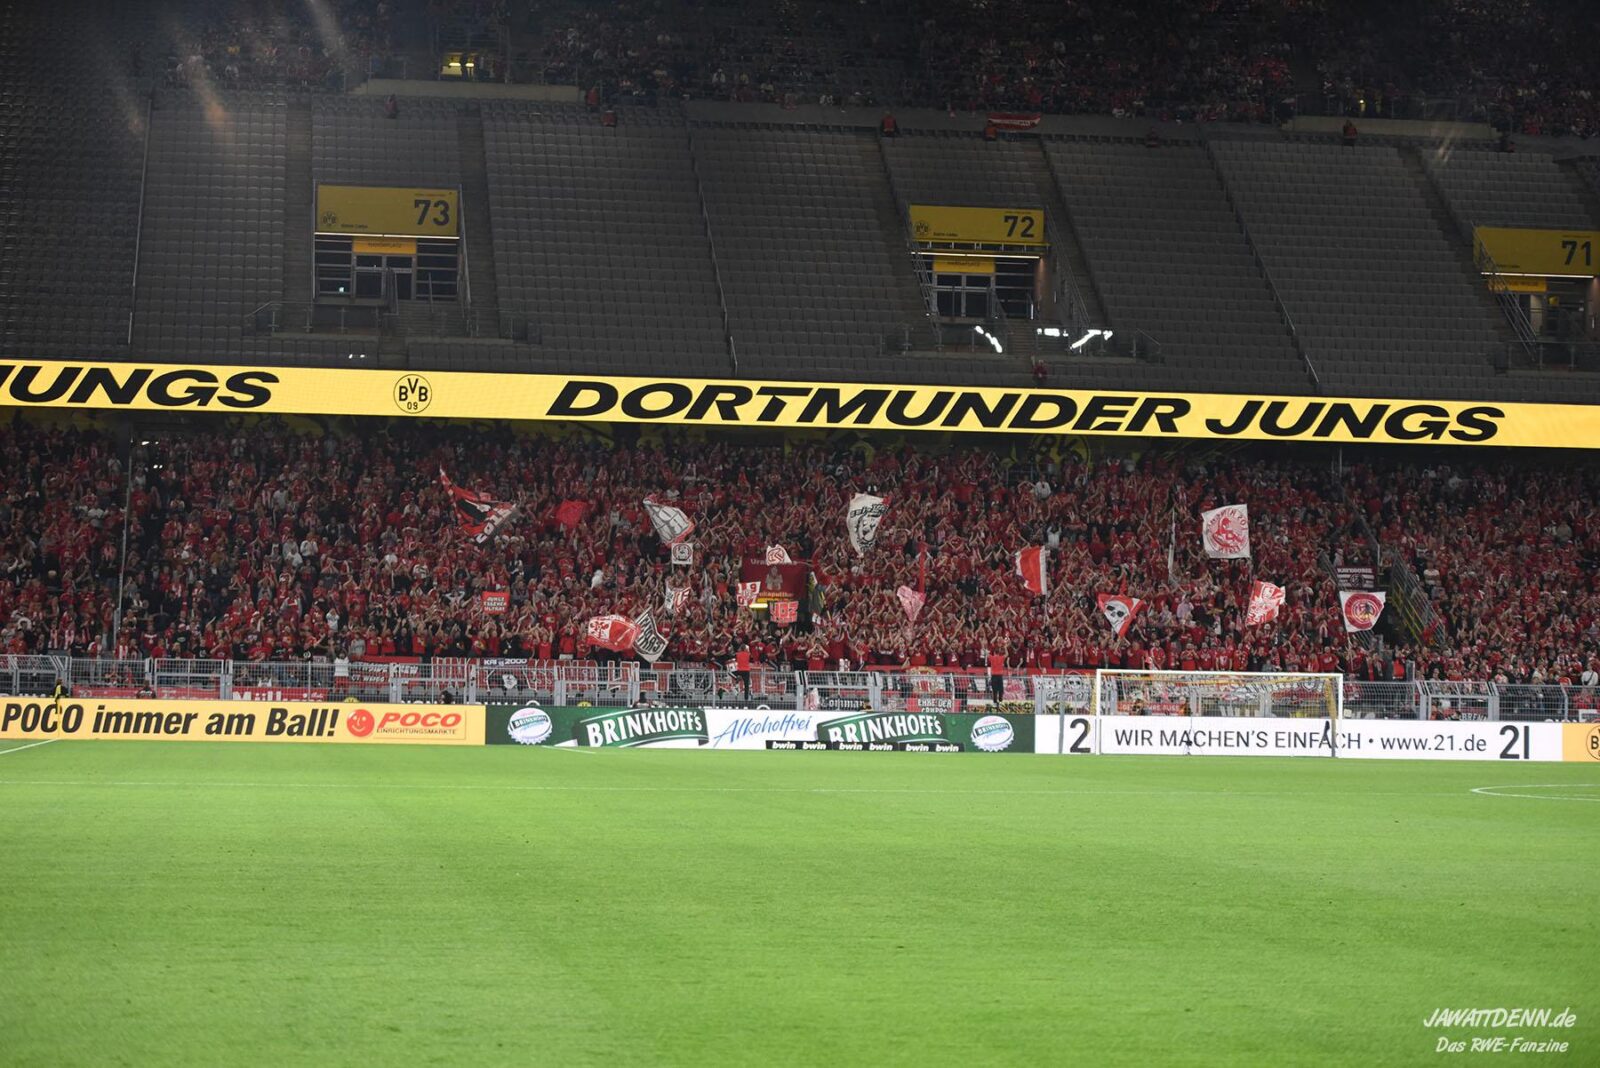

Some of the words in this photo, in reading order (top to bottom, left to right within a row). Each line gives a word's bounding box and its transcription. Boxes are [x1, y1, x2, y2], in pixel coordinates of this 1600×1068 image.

[414, 199, 450, 226] 73
[1003, 215, 1035, 238] 72
[1561, 240, 1592, 266] 71
[399, 378, 428, 402] BVB
[406, 402, 418, 411] 09
[546, 381, 1191, 433] DORTMUNDER
[1206, 401, 1505, 442] JUNGS
[1, 703, 84, 733] POCO
[92, 705, 198, 735] immer
[205, 712, 256, 735] am
[265, 708, 340, 737] Ball!
[378, 712, 462, 728] POCO
[714, 712, 812, 747] Alkoholfrei
[772, 741, 796, 749] bwin
[802, 741, 827, 750] bwin
[839, 742, 863, 751] bwin
[869, 742, 893, 751] bwin
[906, 743, 930, 752] bwin
[935, 744, 959, 753] bwin
[1115, 729, 1153, 746] WIR
[1160, 729, 1268, 748] MACHEN'S
[1381, 733, 1487, 752] www.21.de
